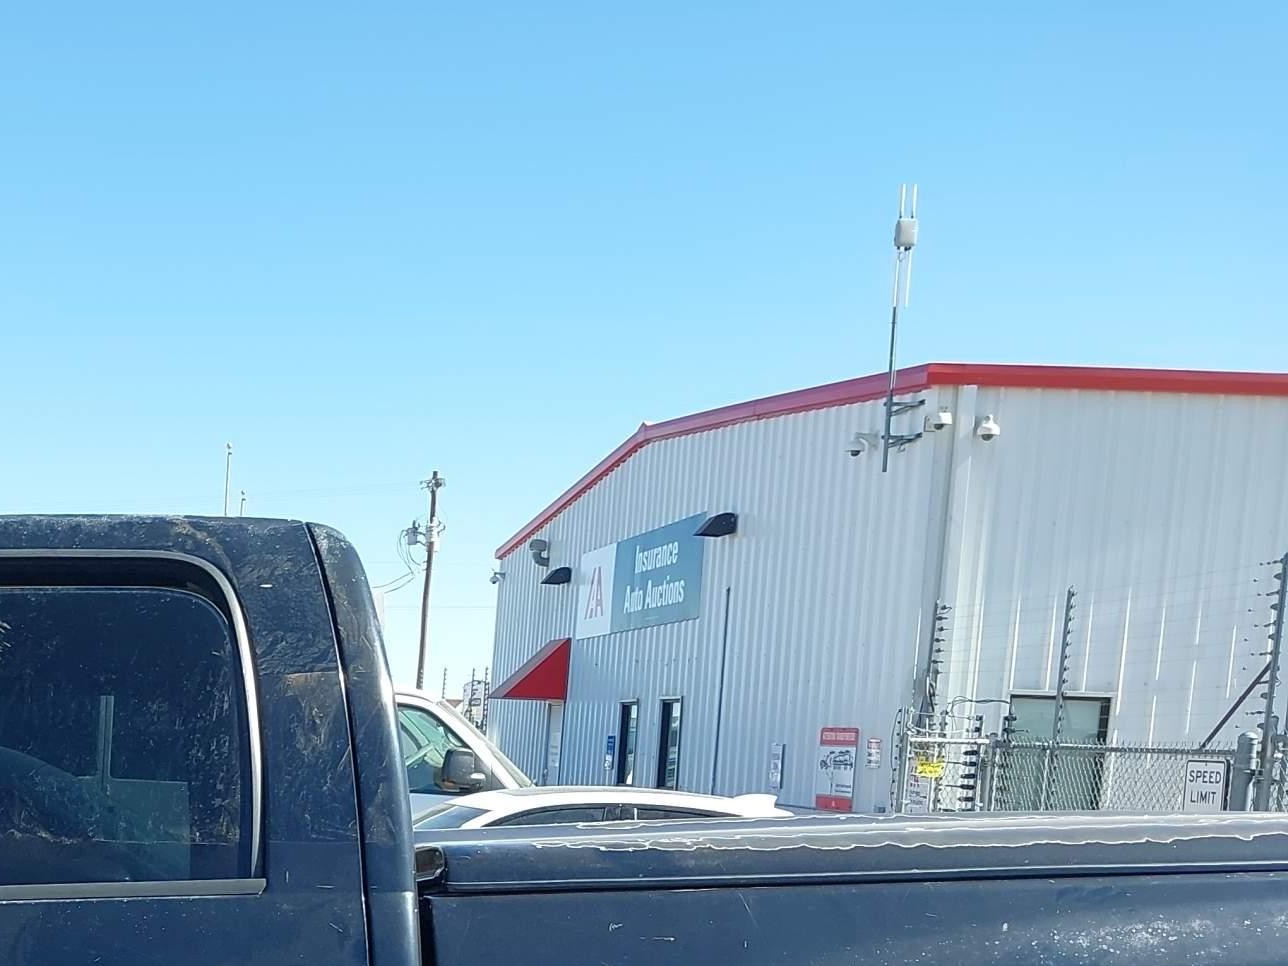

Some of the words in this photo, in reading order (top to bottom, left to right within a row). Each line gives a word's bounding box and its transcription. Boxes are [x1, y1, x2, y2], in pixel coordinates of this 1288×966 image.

[634, 541, 679, 574] Insurance
[623, 585, 644, 614] Auto
[643, 575, 685, 610] Auctions
[1188, 770, 1222, 784] SPEED
[1190, 791, 1216, 804] LIMIT
